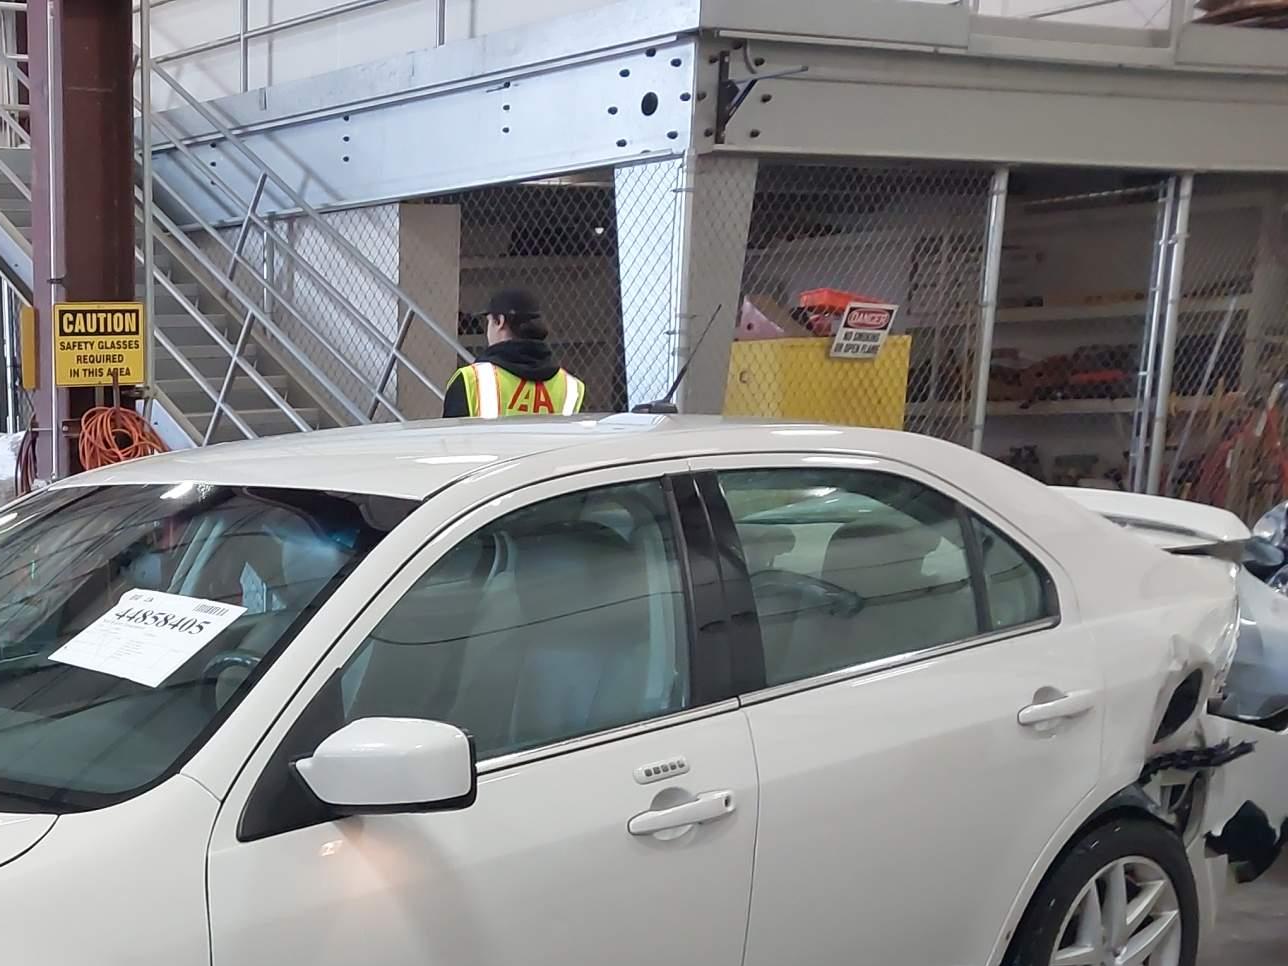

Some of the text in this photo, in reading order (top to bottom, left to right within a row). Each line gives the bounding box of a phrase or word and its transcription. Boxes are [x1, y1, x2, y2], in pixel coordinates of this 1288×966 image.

[62, 312, 137, 333] CAUTION
[59, 340, 140, 351] SAFETY GLASSES
[76, 354, 124, 364] REQUIRED
[69, 368, 80, 378] IN
[82, 368, 104, 378] THIS
[115, 607, 210, 635] 44858405
